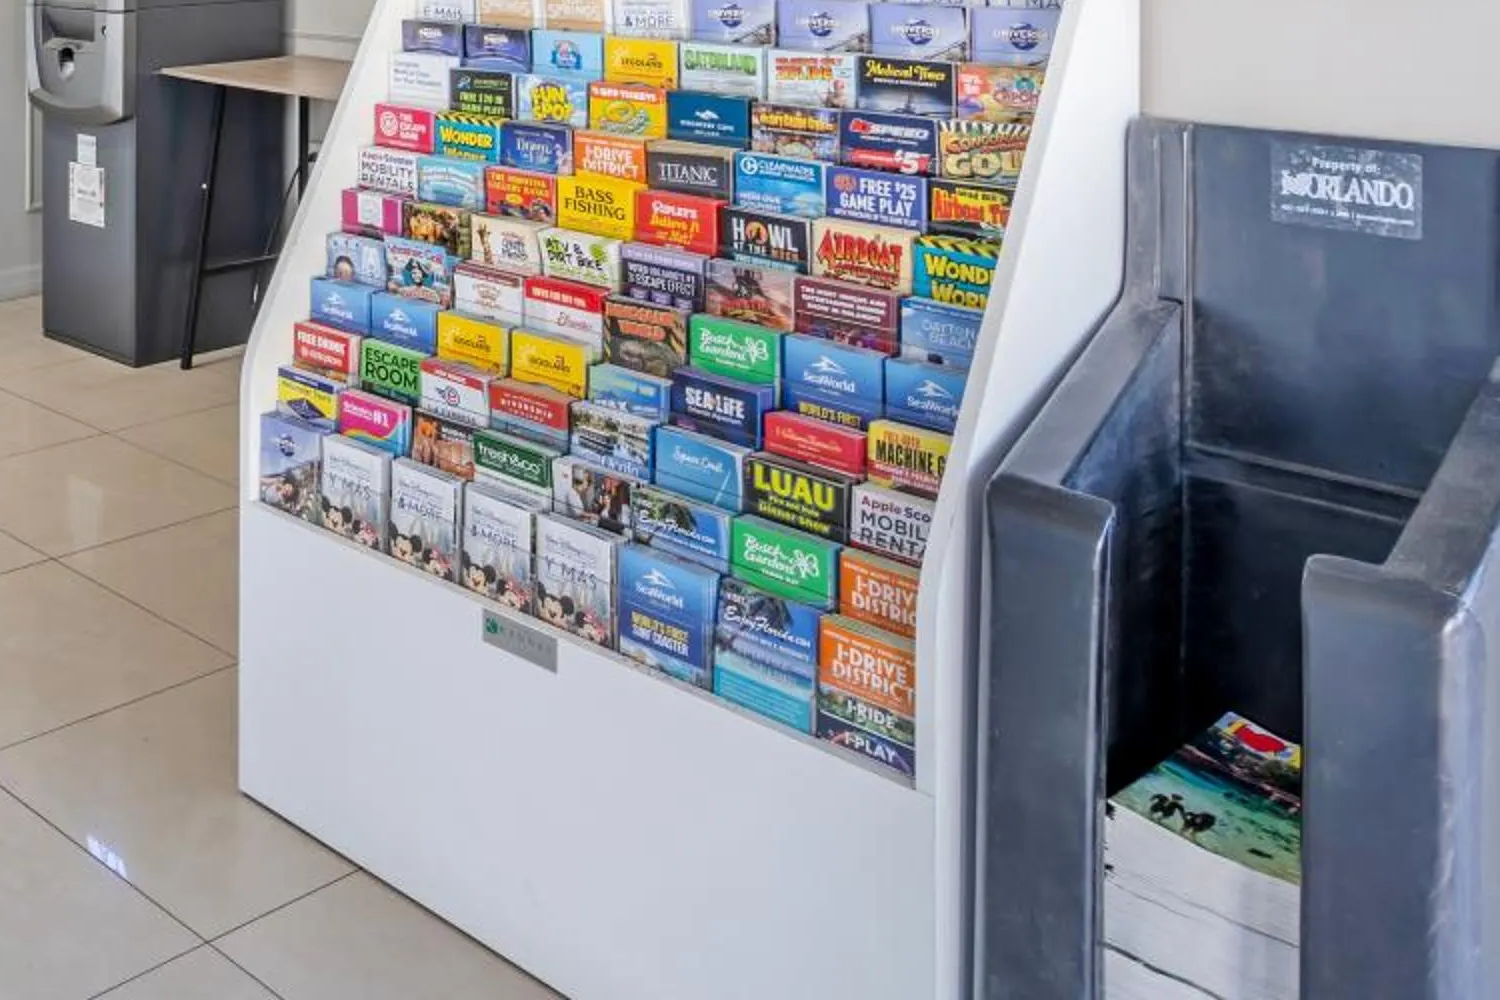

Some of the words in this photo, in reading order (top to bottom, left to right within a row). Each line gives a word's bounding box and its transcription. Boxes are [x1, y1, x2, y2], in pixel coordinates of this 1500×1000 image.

[866, 59, 913, 77] Medieval
[914, 64, 946, 81] Times
[439, 125, 493, 148] WONDER
[361, 162, 413, 178] MOBILITY
[658, 162, 717, 181] TITANIC
[1312, 156, 1362, 173] Property
[361, 175, 413, 191] RENTALS
[575, 185, 613, 205] BASS
[860, 178, 892, 197] FREE
[895, 181, 917, 201] $25
[564, 197, 626, 221] FISHING
[840, 192, 877, 212] GAME
[880, 198, 913, 218] PLAY
[816, 228, 903, 272] AIRBOAT
[365, 347, 419, 373] ESCAPE
[365, 362, 418, 391] ROOM
[803, 371, 856, 393] SeaWorld
[685, 387, 713, 410] SEA
[715, 396, 746, 420] LIFE
[875, 440, 933, 472] MACHINE
[754, 463, 836, 511] LUAU
[862, 495, 901, 516] Apple
[861, 510, 930, 542] MOBIL
[860, 527, 927, 558] RENT
[857, 574, 916, 606] I-DRIV
[851, 592, 916, 628] DISTRIC
[836, 642, 908, 688] I-DRIVE
[832, 660, 915, 702] DISTRICT
[847, 699, 897, 729] I-RIDE
[844, 730, 896, 764] I-PLAY
